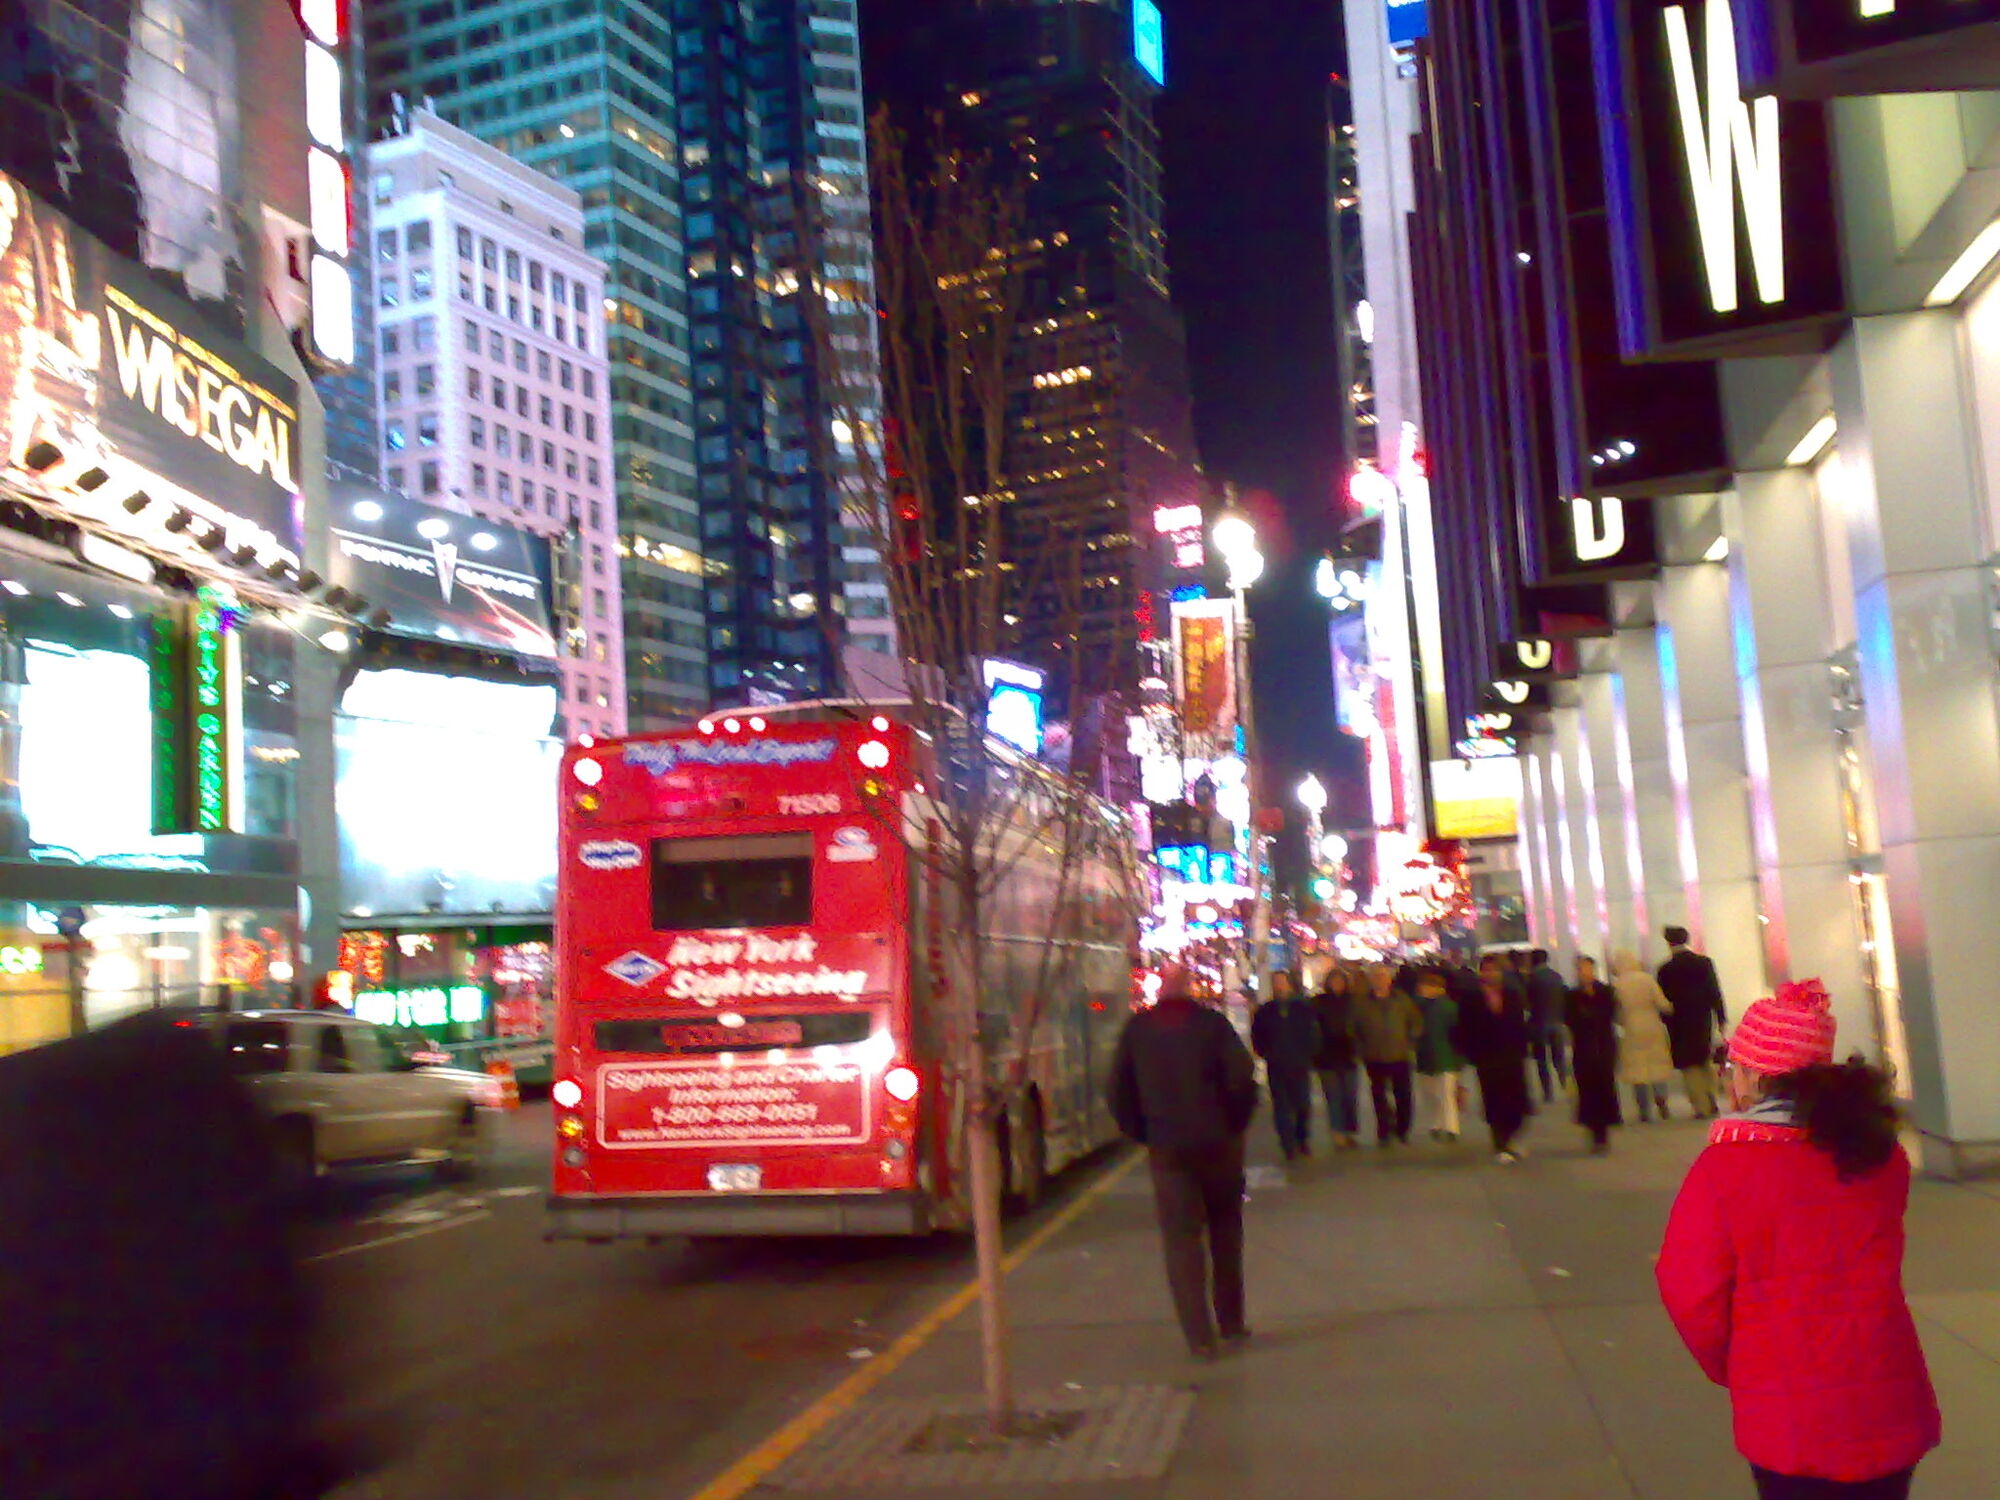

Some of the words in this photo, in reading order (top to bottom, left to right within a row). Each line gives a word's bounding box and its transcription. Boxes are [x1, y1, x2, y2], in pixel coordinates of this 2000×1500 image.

[666, 936, 742, 965] New
[744, 932, 818, 963] York
[665, 965, 868, 1007] Sightseeing
[606, 1070, 732, 1092] Sightseeing
[733, 1069, 774, 1085] and
